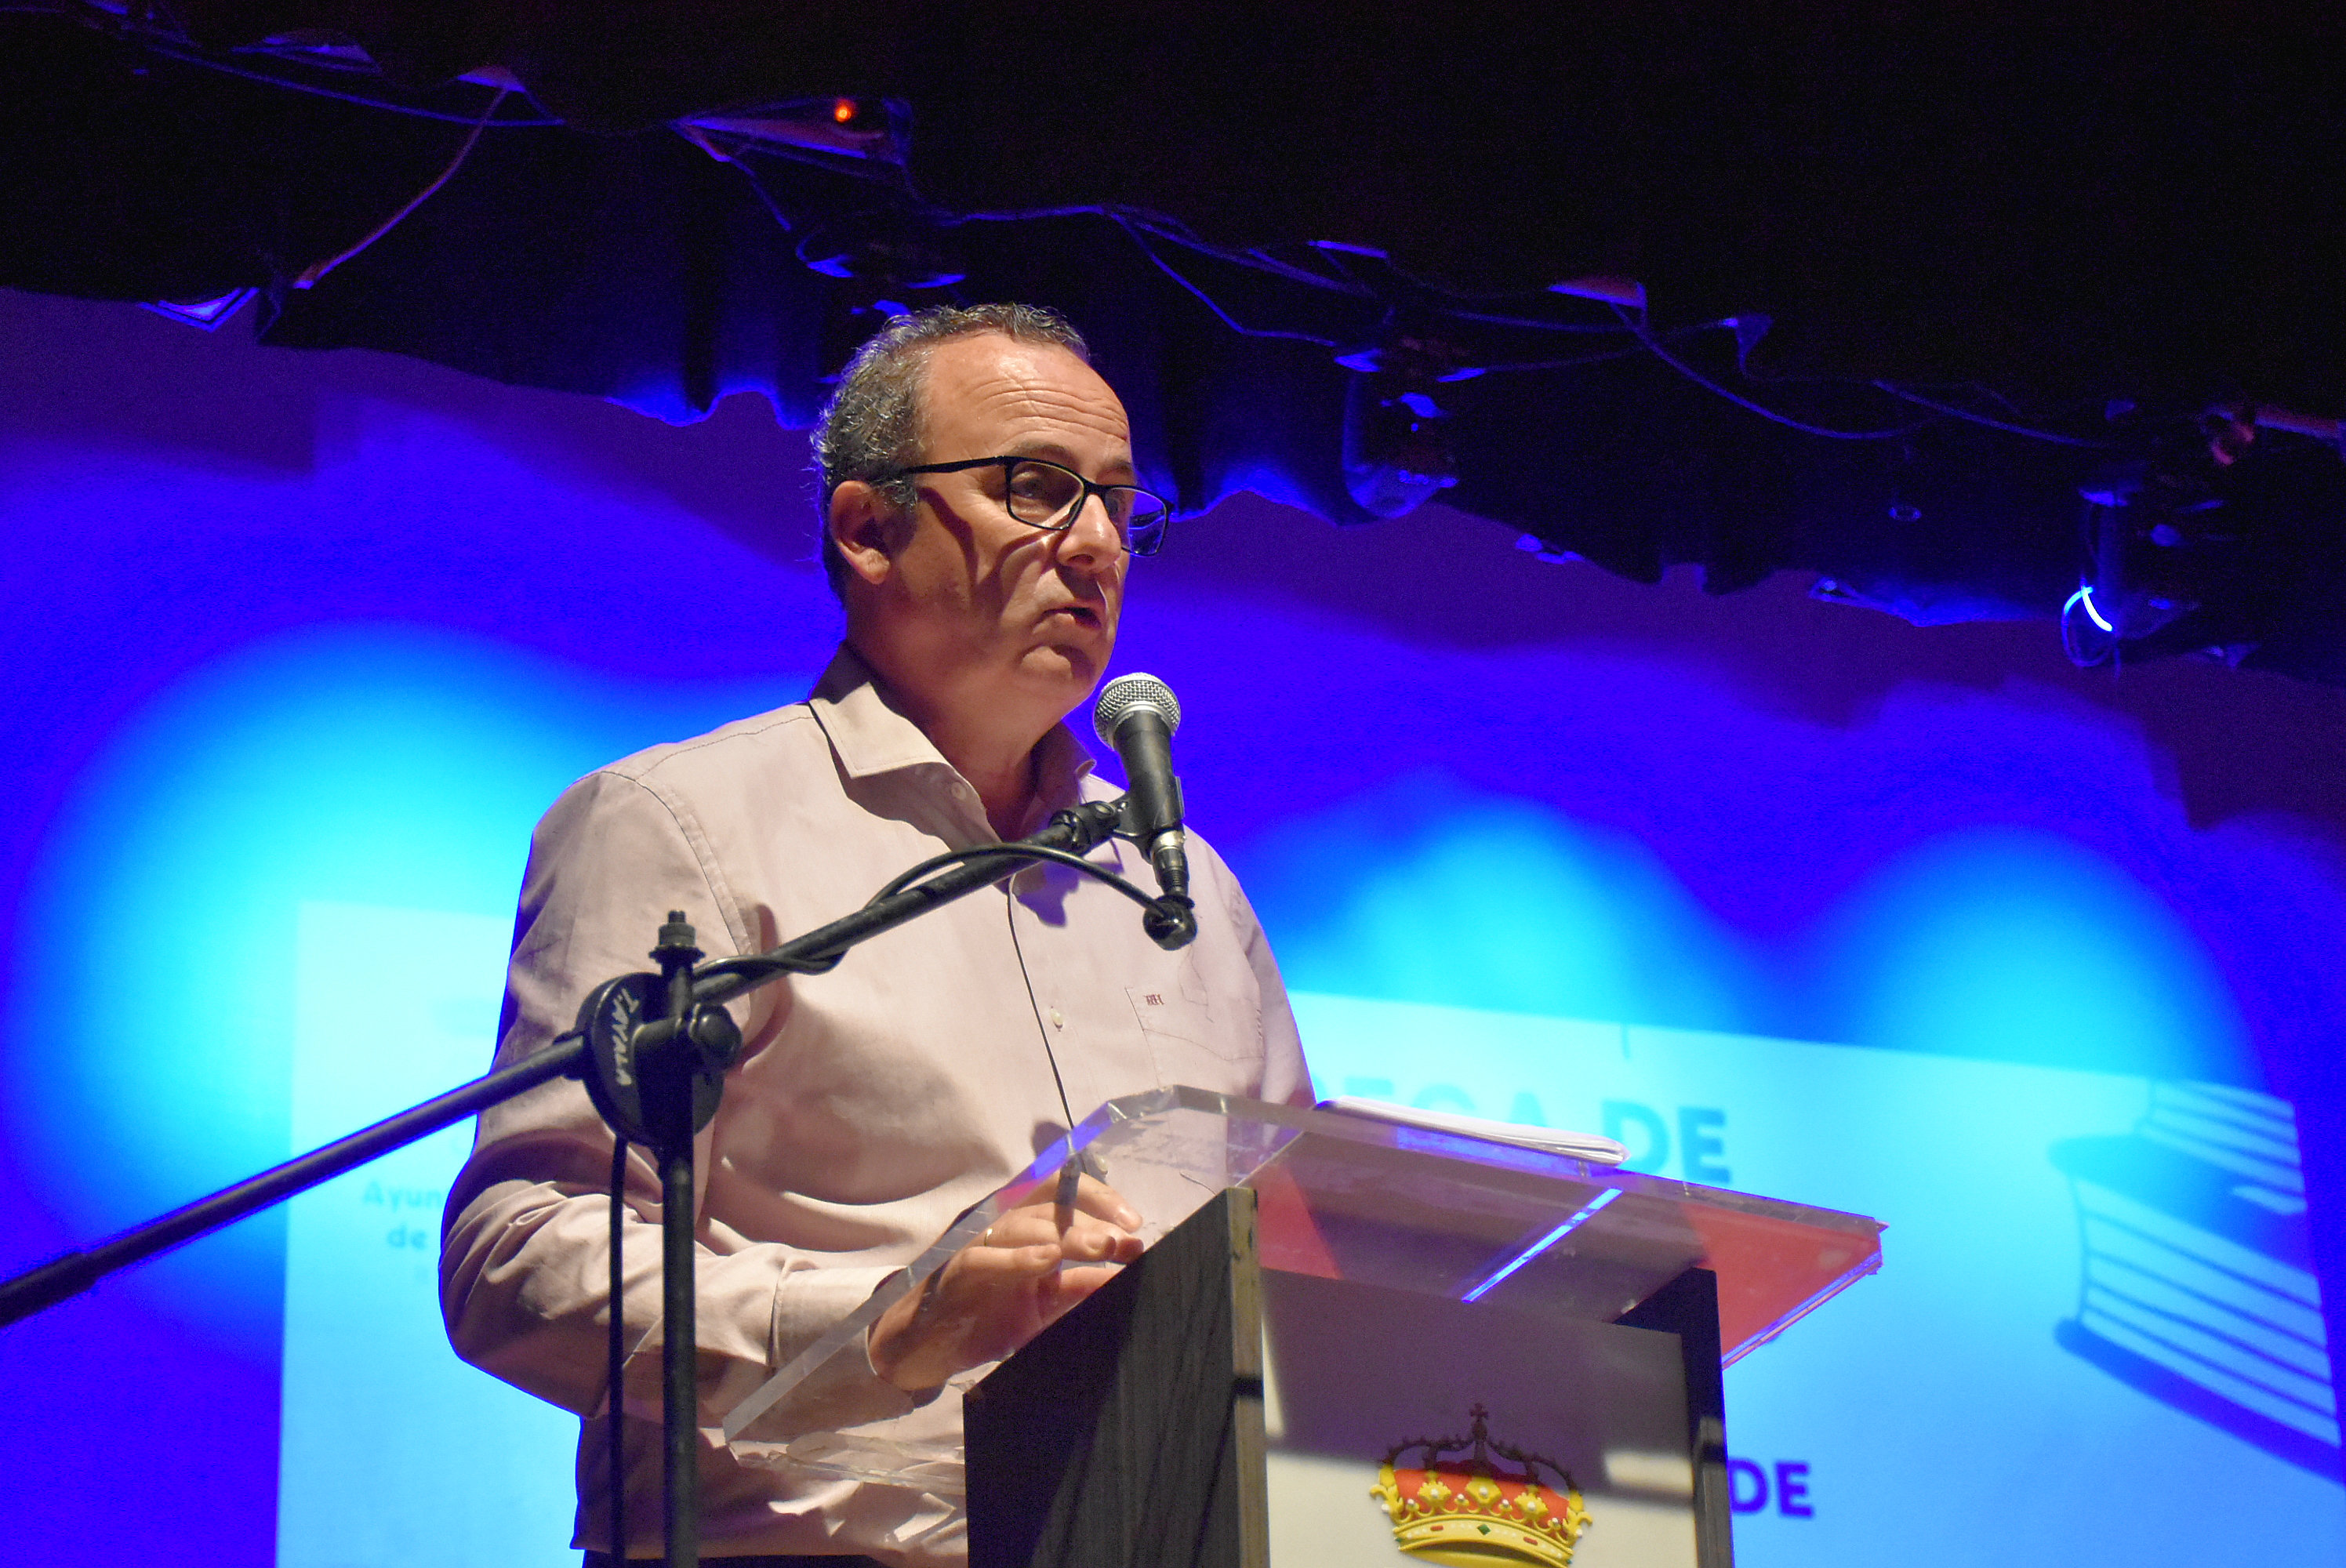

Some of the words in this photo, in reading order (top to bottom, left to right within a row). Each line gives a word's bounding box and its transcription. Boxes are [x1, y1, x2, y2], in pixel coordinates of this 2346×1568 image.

[1600, 1098, 1732, 1185] DE
[363, 1180, 445, 1212] Ayun
[386, 1224, 428, 1250] de
[1727, 1457, 1814, 1517] DE
